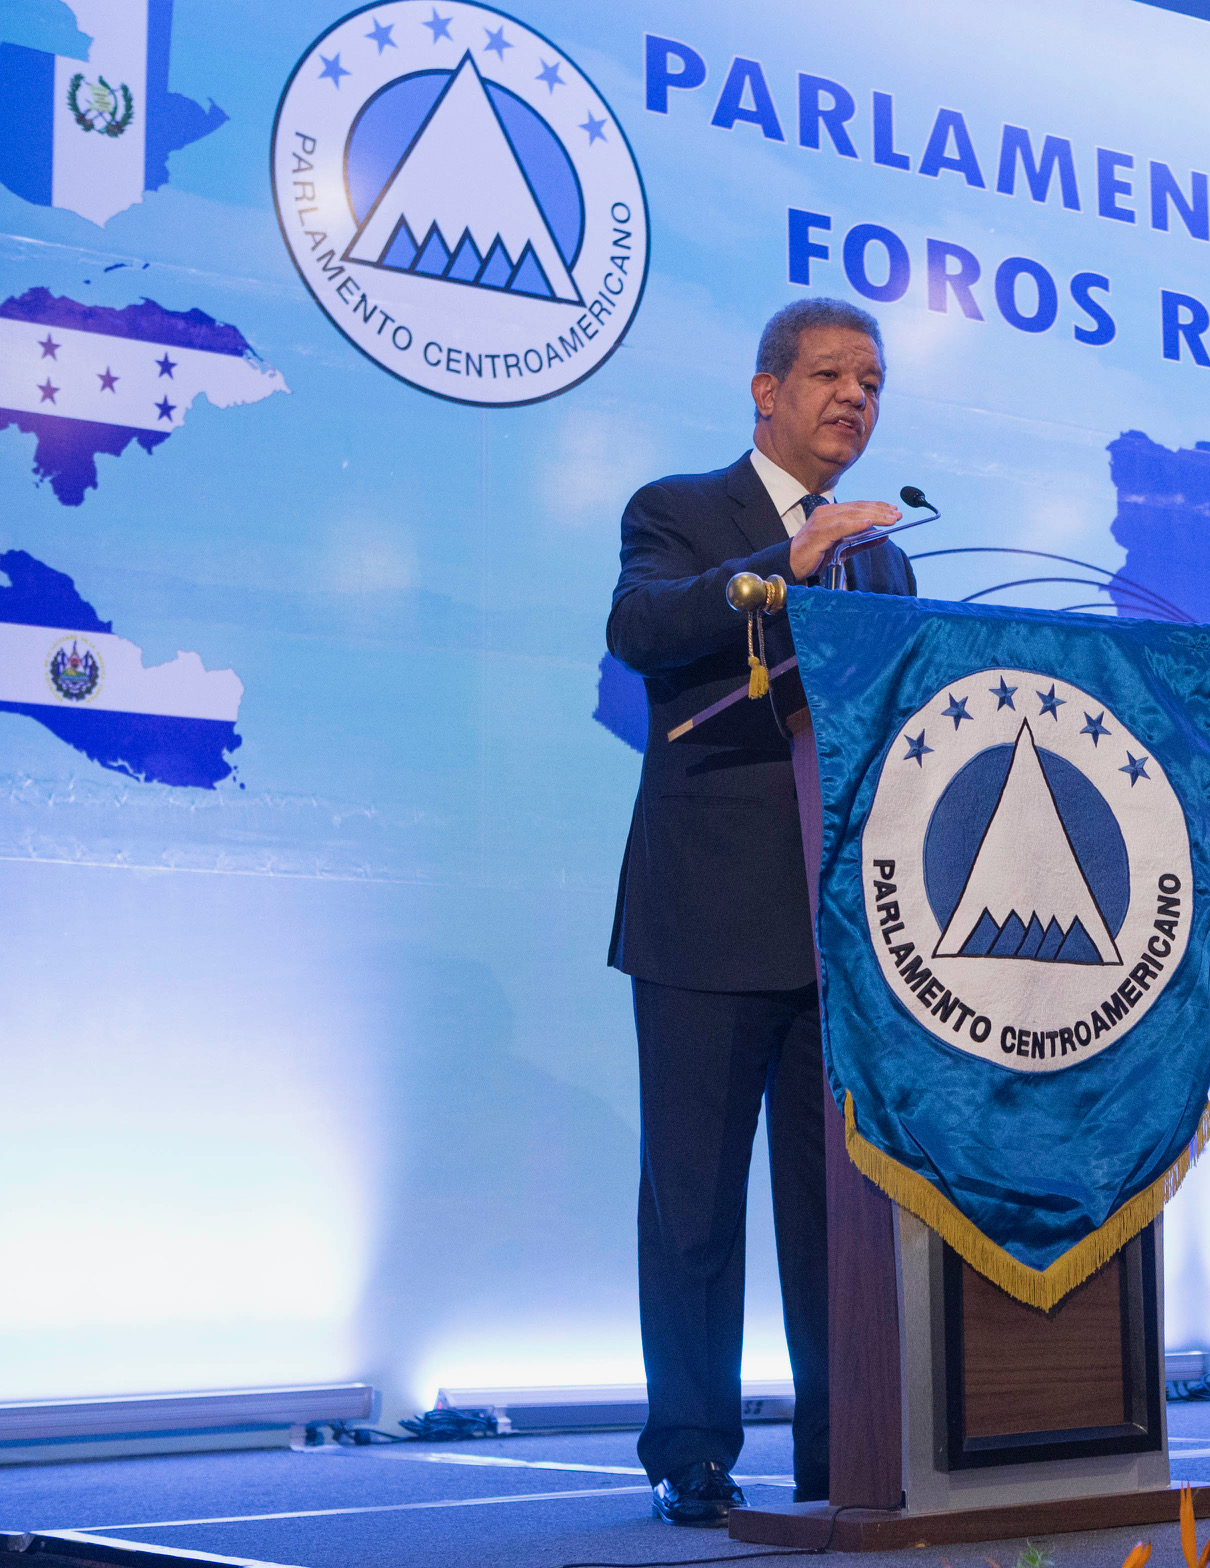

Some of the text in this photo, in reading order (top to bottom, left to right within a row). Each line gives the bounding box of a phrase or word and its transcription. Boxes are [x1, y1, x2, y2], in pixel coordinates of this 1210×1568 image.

[290, 130, 632, 379] PARLAMENTO CENTROAMERICANO
[787, 206, 1118, 347] FOROS
[872, 858, 1182, 1060] PARLAMENTO CENTROAMERICANO
